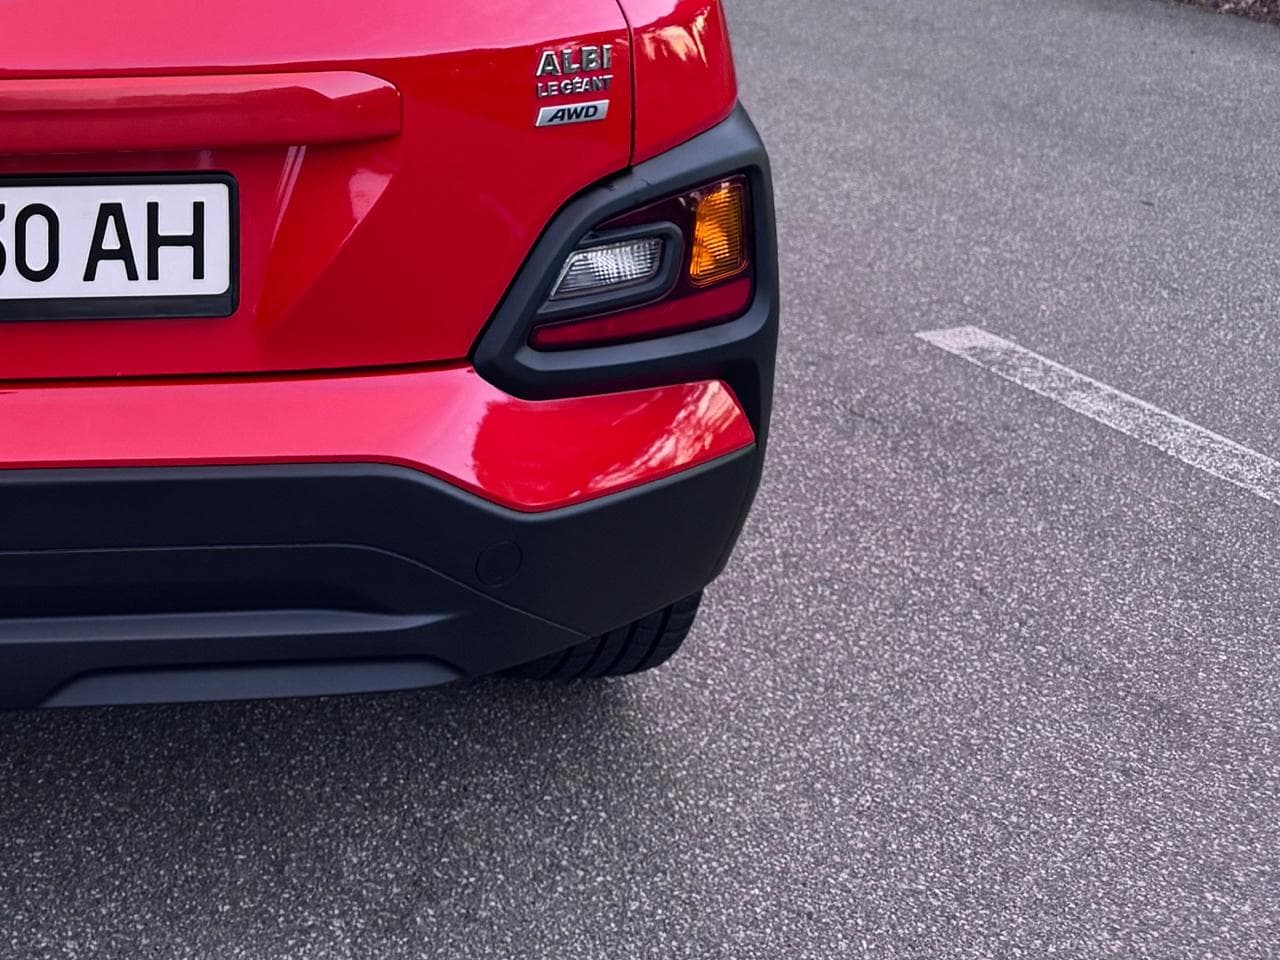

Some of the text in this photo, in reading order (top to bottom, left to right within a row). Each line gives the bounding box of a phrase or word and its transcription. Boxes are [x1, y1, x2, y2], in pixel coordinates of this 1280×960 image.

[536, 44, 613, 76] ALBI
[547, 104, 598, 123] AWD
[82, 201, 205, 282] AH
